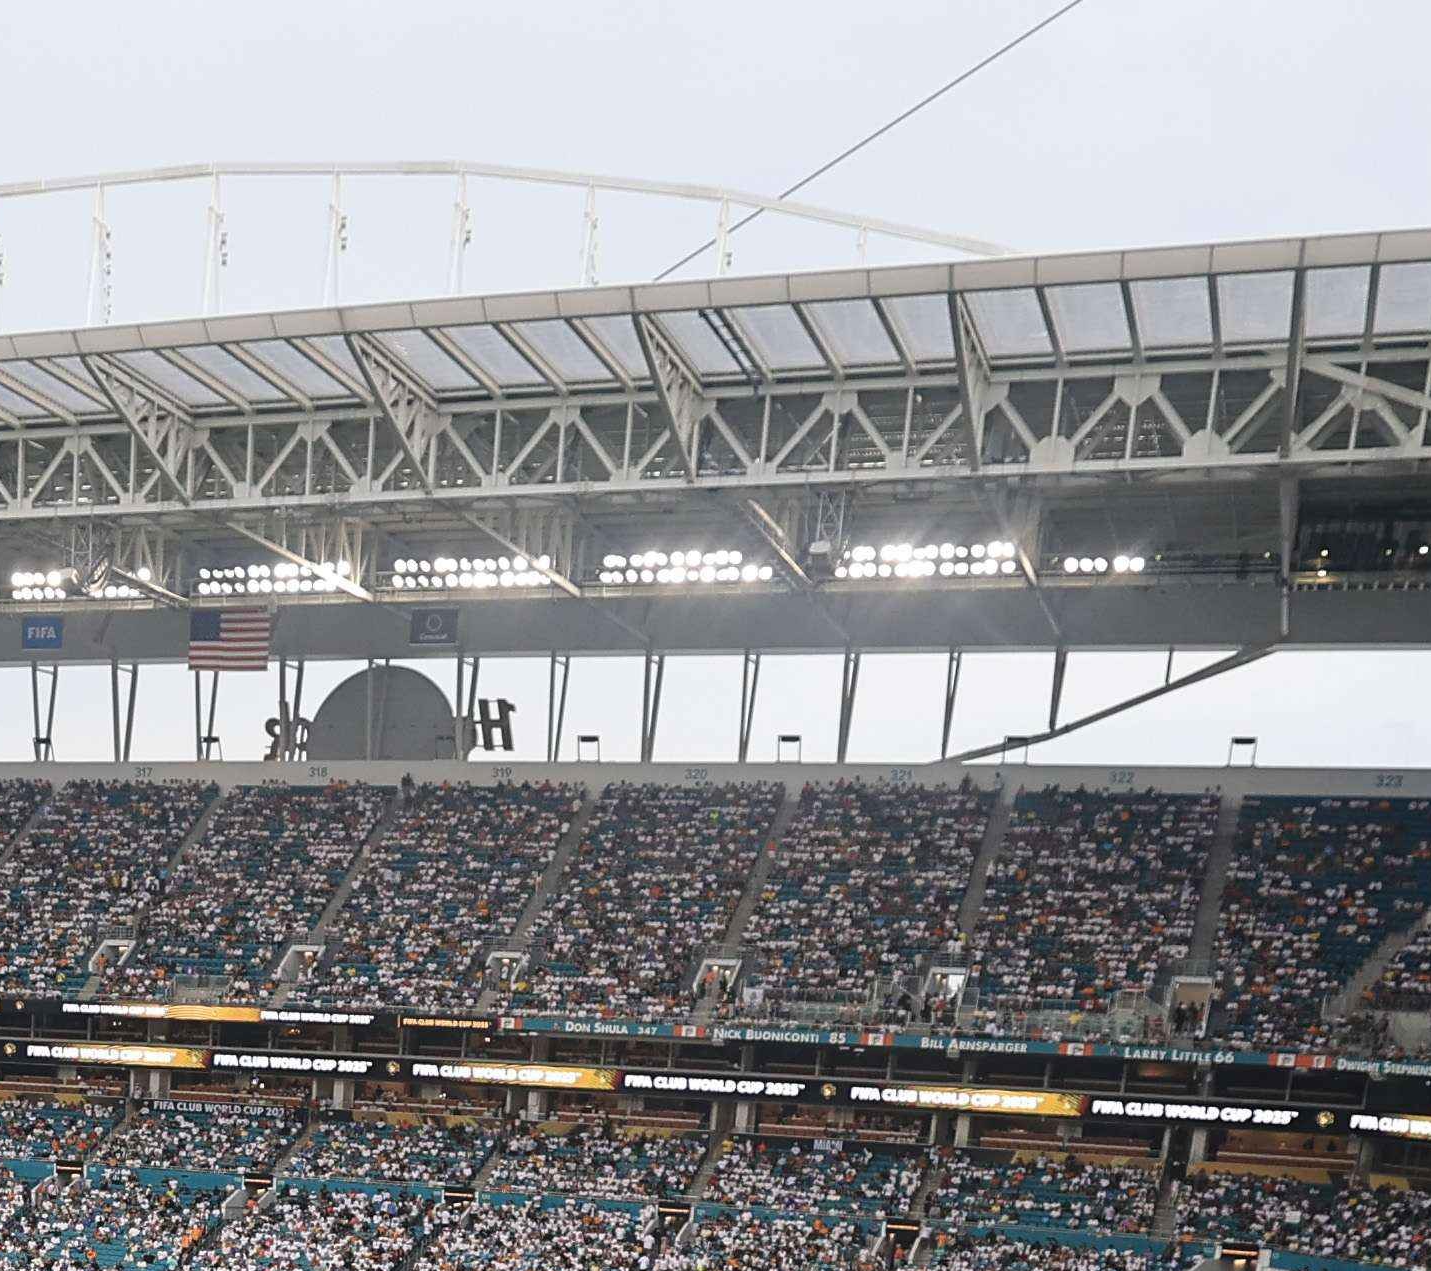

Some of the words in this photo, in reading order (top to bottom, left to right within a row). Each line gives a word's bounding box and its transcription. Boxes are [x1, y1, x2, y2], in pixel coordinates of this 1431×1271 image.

[28, 625, 58, 641] FIFA
[135, 767, 153, 778] 317
[309, 767, 328, 779] 318
[565, 1021, 592, 1033] DON
[594, 1022, 629, 1035] SHULA
[713, 1029, 740, 1041] NICK
[746, 1030, 820, 1044] BUONICONTI
[829, 1032, 847, 1044] 85
[921, 1037, 945, 1049] BILL
[947, 1038, 1028, 1054] ARNSPARGER
[1124, 1049, 1167, 1061] LARRY
[1171, 1050, 1213, 1064] LITTLE
[1214, 1052, 1235, 1064] 66
[1339, 1059, 1381, 1072] DWIGHT
